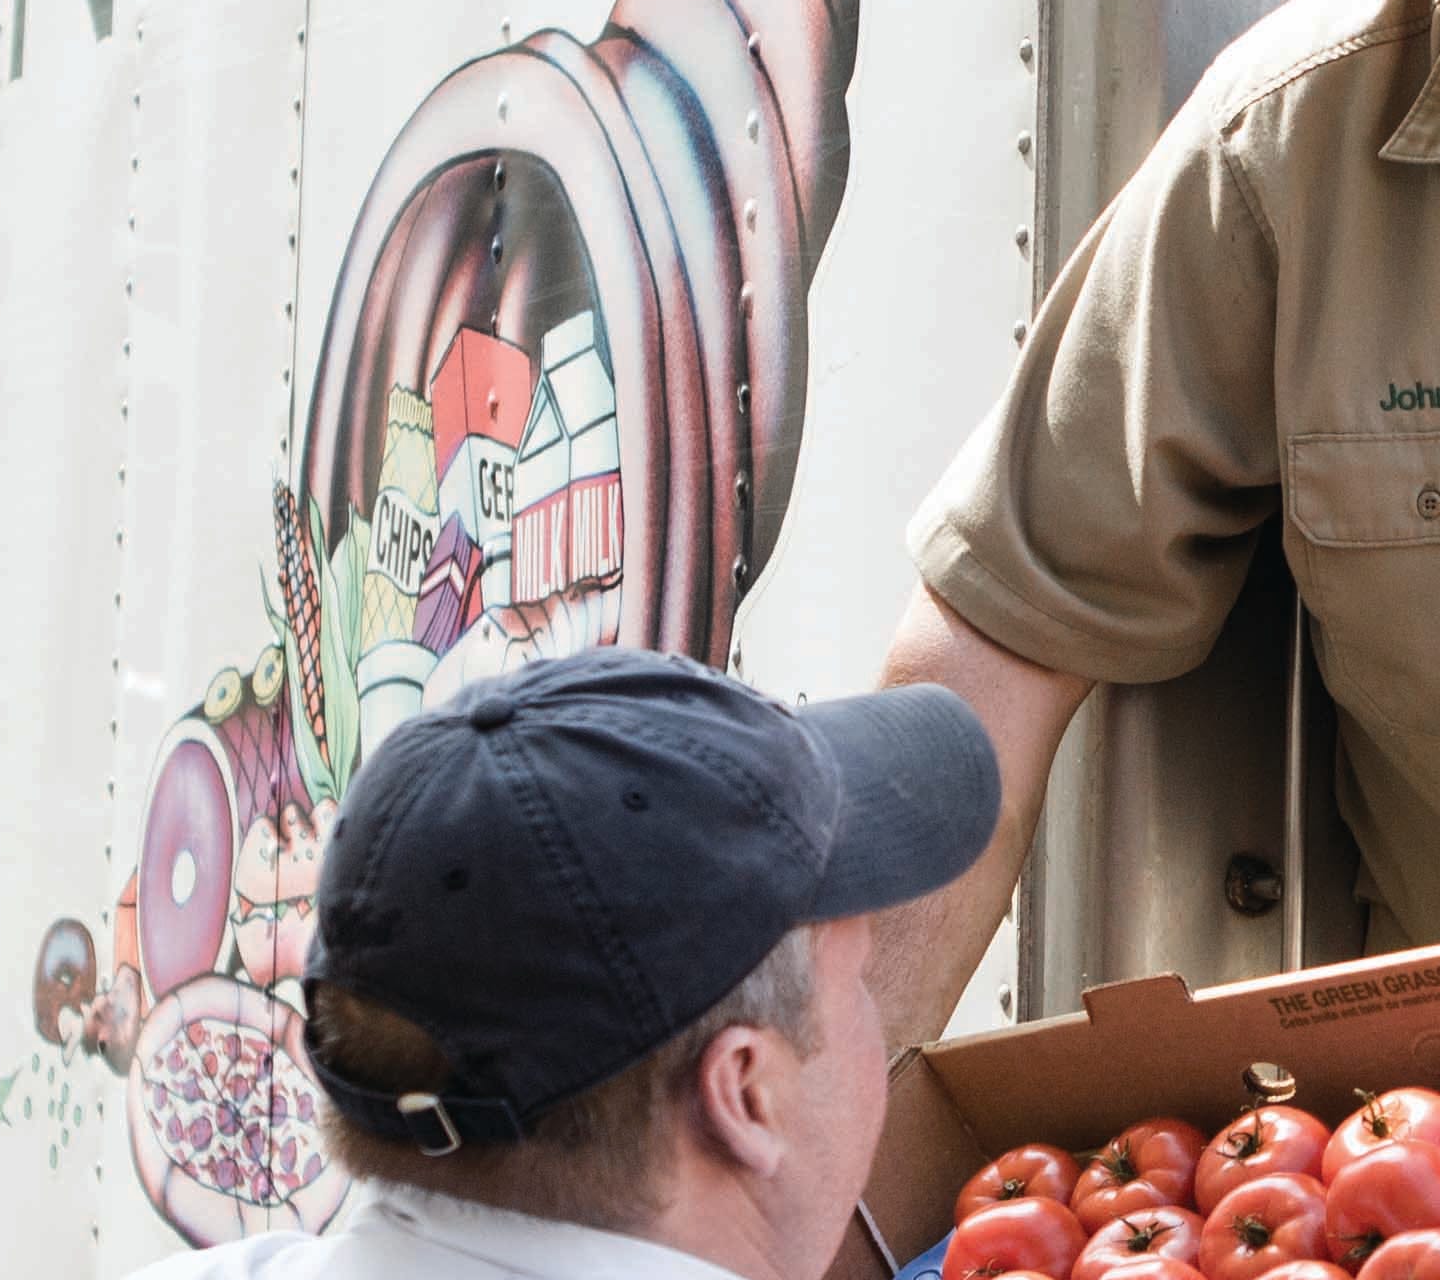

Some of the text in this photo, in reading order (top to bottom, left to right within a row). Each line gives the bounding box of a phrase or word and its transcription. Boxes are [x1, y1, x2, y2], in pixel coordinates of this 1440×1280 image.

[515, 480, 621, 603] MILK MILK
[1268, 991, 1311, 1016] THE
[1313, 979, 1381, 1008] GREEN
